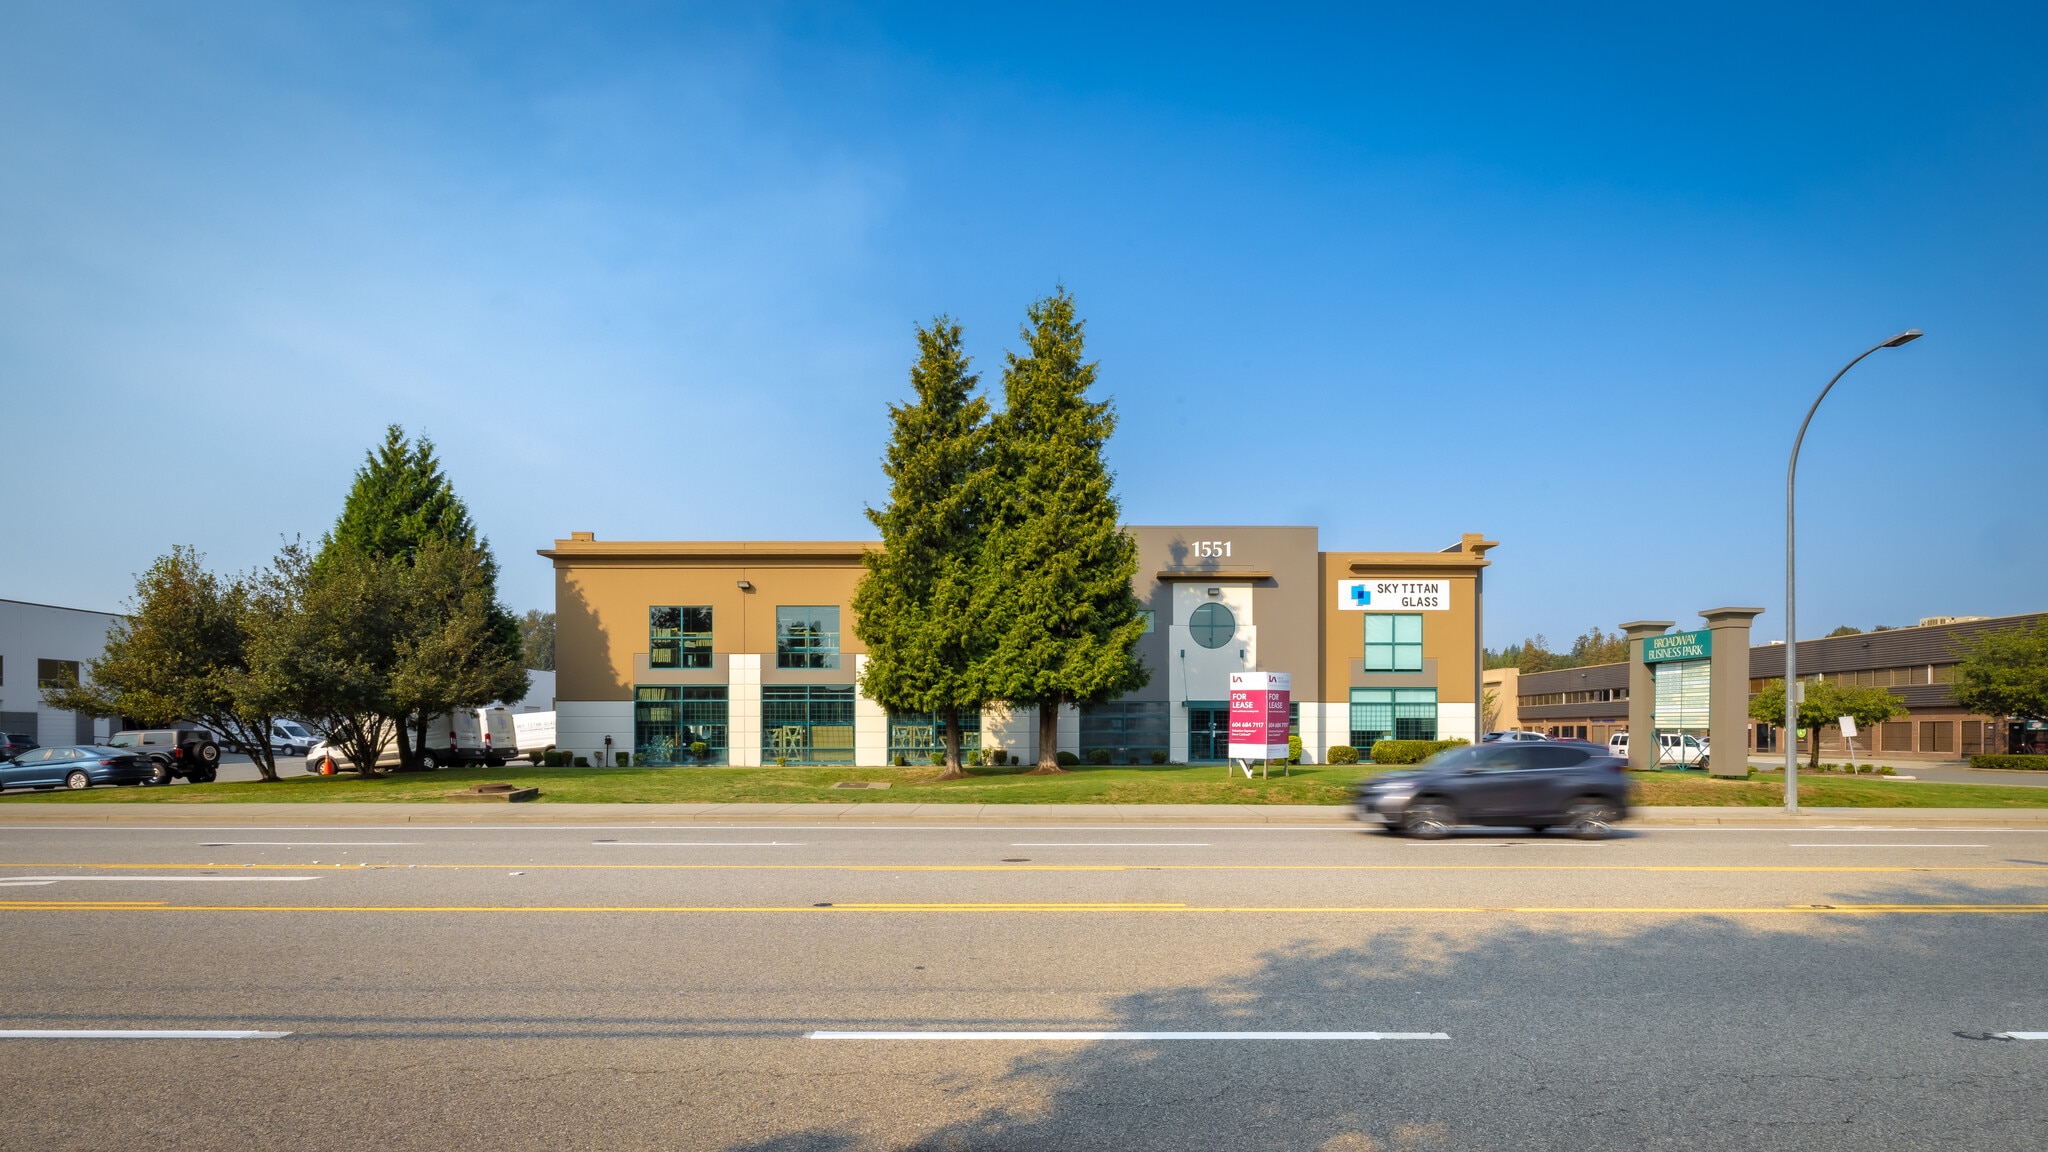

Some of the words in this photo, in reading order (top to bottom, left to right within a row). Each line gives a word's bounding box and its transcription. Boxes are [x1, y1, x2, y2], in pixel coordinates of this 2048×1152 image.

[1191, 541, 1231, 558] 1551
[1377, 583, 1399, 594] SKY
[1401, 583, 1439, 594] TITAN
[1401, 597, 1438, 607] GLASS
[1653, 634, 1698, 649] BROADWAY
[1648, 647, 1682, 660] BUSINESS
[1682, 645, 1704, 657] PARK
[1232, 701, 1254, 709] LEASE
